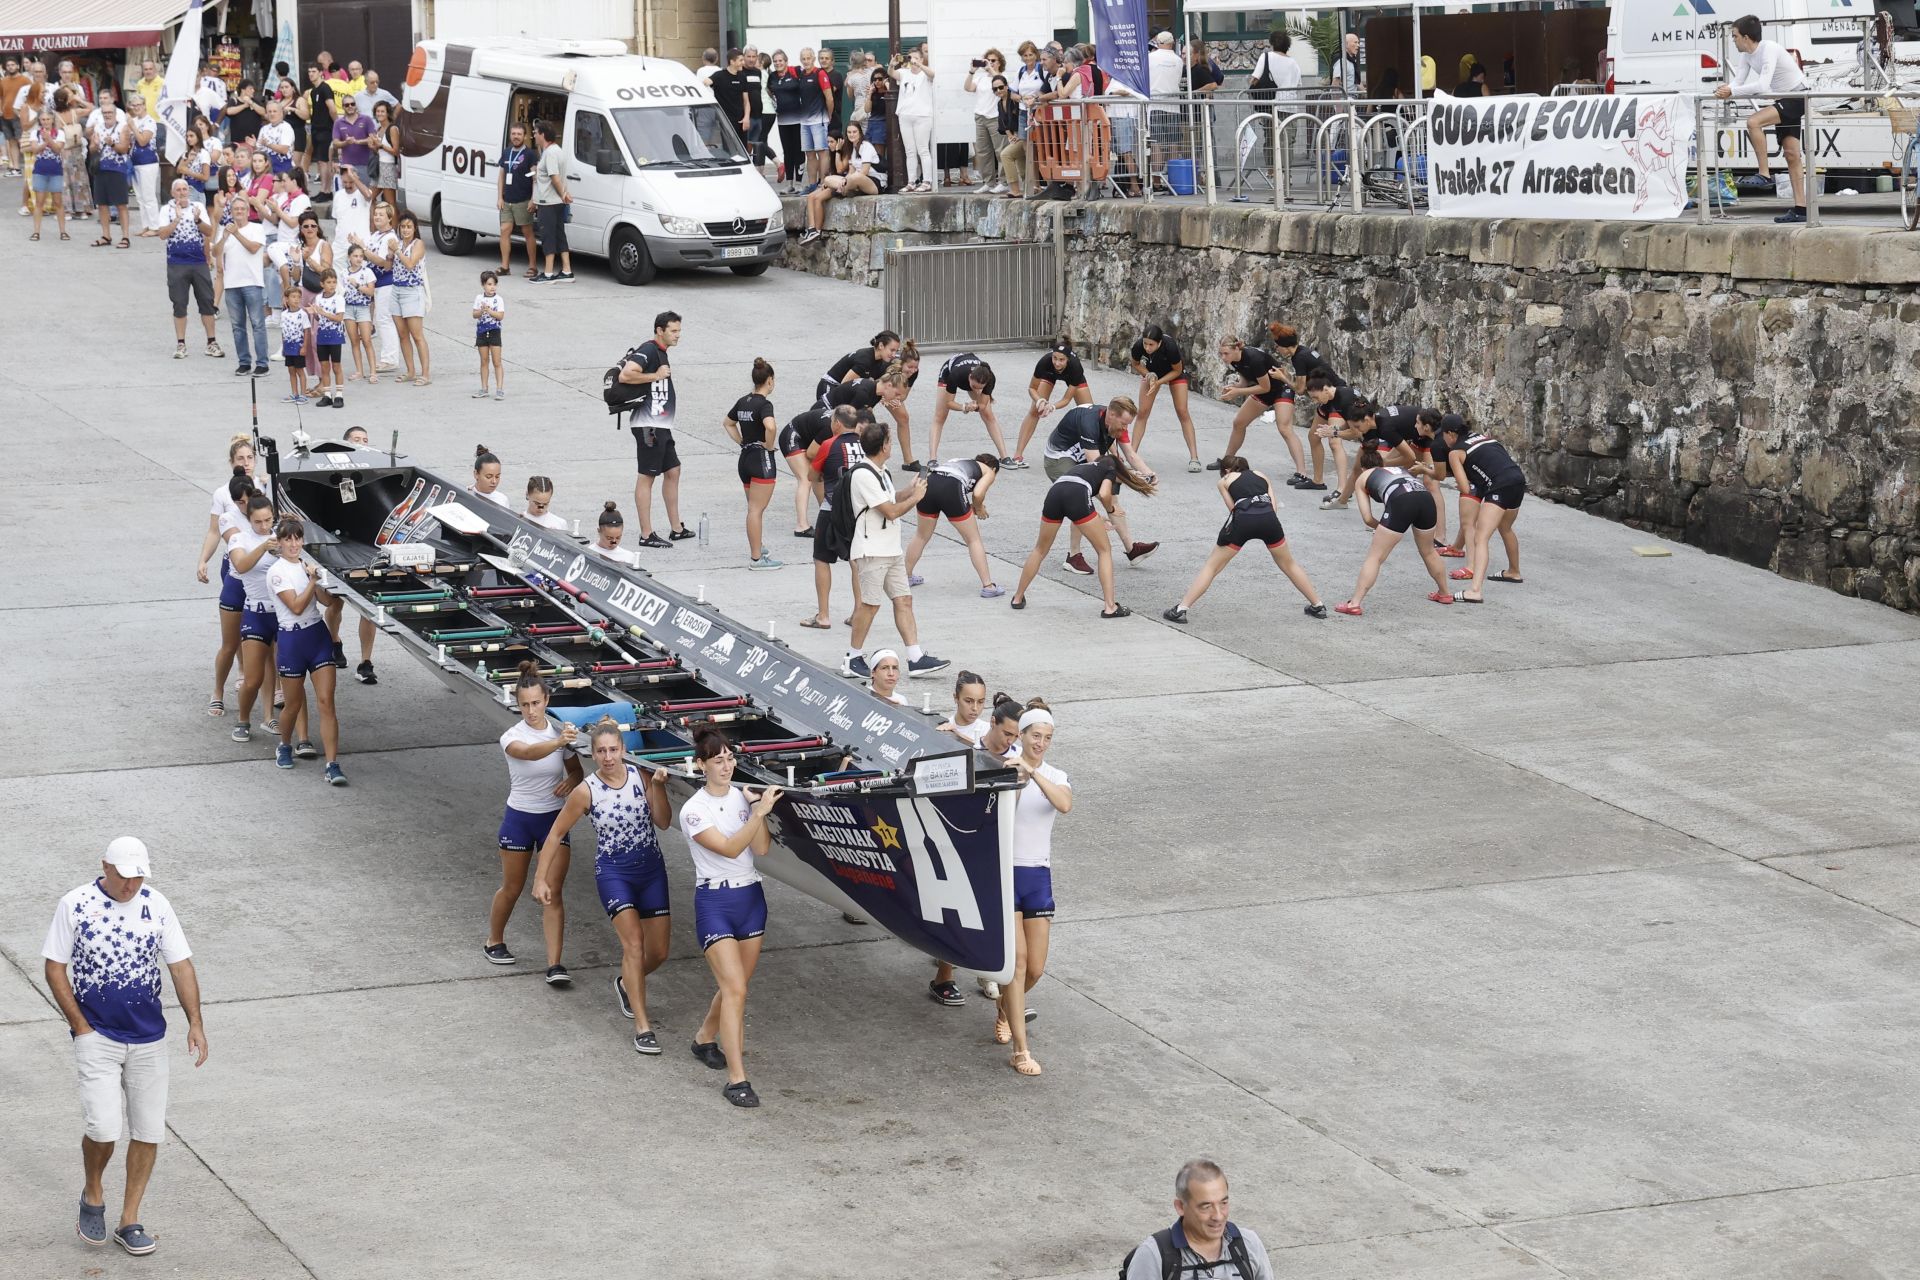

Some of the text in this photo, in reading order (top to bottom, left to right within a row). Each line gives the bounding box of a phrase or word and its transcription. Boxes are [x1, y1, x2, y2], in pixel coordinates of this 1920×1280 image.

[32, 36, 89, 50] AQUARIUM
[616, 83, 703, 101] overon
[1431, 98, 1638, 146] GUDARI EGUNA
[441, 144, 486, 178] ron
[1435, 157, 1636, 196] Irailak 27 Arrasaten
[651, 391, 669, 401] BAI
[580, 564, 611, 592] Lurauto
[614, 587, 666, 623] DRUCK
[682, 615, 709, 636] EROSKI
[735, 660, 755, 678] ve
[790, 802, 858, 825] ARRAUN
[803, 823, 894, 849] LAGUNAK 11
[817, 843, 898, 873] DONOSTIA
